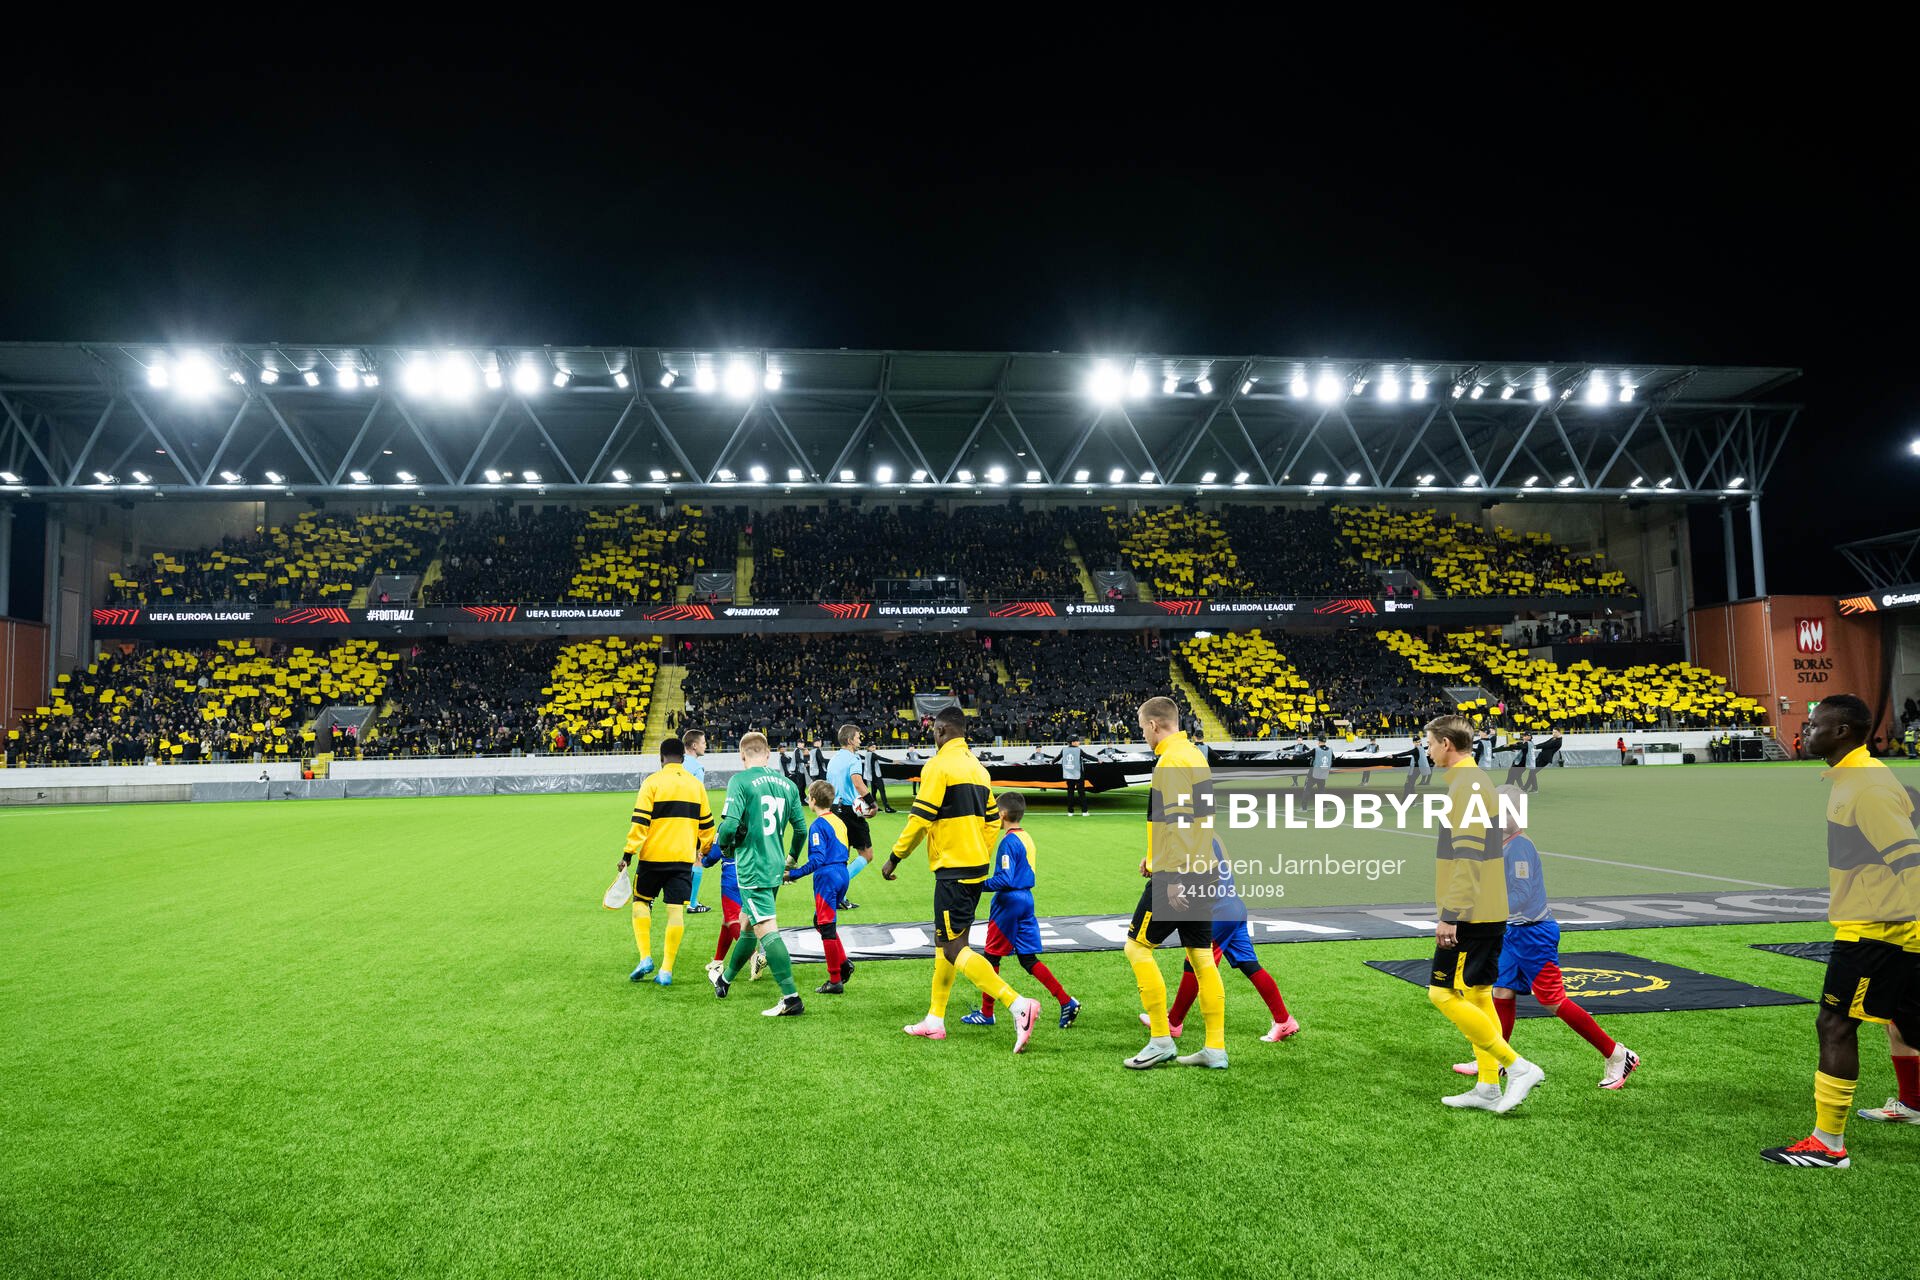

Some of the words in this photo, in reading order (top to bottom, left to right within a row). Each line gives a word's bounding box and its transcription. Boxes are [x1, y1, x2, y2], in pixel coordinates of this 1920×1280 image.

[1892, 593, 1920, 605] Swissq
[878, 607, 902, 615] UEFA
[902, 606, 936, 615] EUROPA
[1075, 604, 1115, 613] STRAUSS
[1210, 604, 1231, 612] UEFA
[1232, 603, 1263, 612] EUROPA
[149, 613, 175, 621] UEFA
[176, 612, 213, 621] EUROPA
[366, 609, 414, 621] #FOOTBALL
[526, 610, 550, 618] UEFA
[551, 609, 586, 618] EUROPA
[1793, 656, 1833, 670] BORÅS
[1798, 671, 1828, 683] STAD
